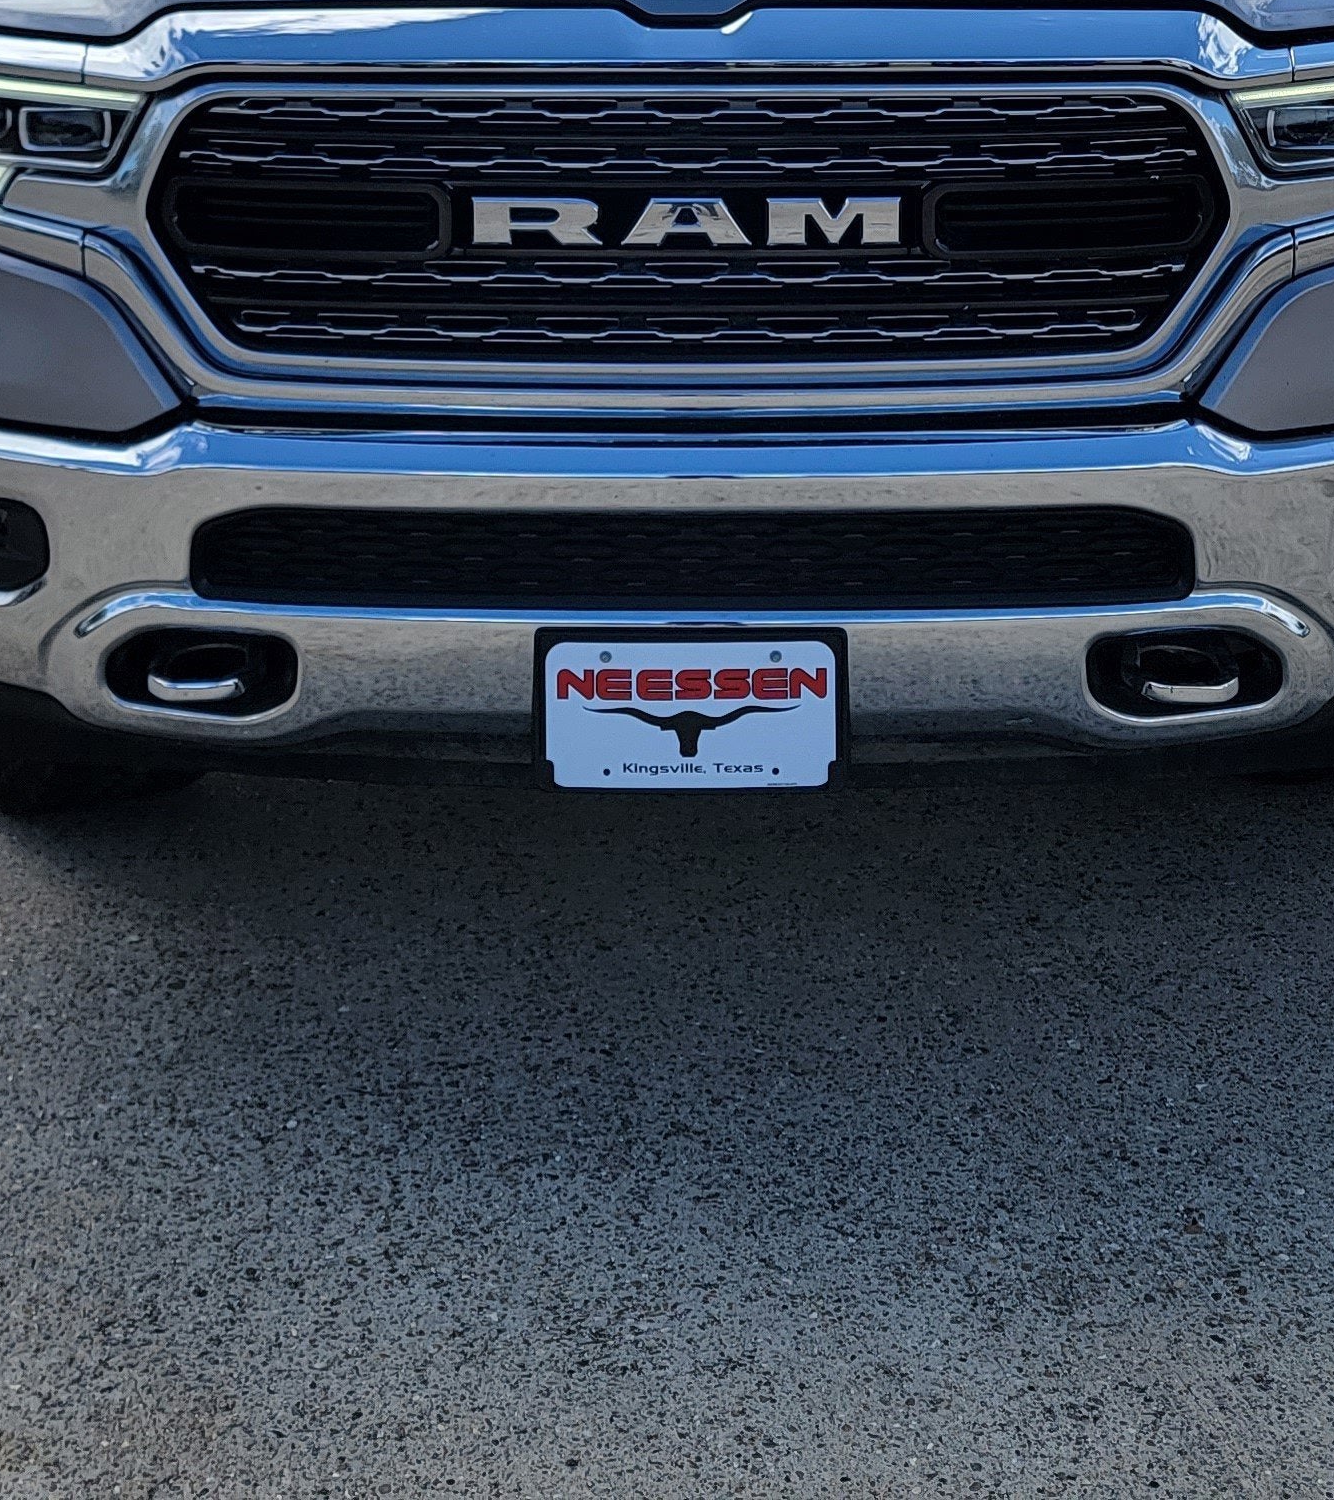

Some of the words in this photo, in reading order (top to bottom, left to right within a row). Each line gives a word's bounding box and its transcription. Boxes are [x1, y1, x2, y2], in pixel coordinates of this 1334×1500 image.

[471, 196, 902, 246] RAM
[556, 667, 828, 700] NEESSEN
[622, 762, 707, 776] Kingsville,
[713, 762, 764, 773] Texas
